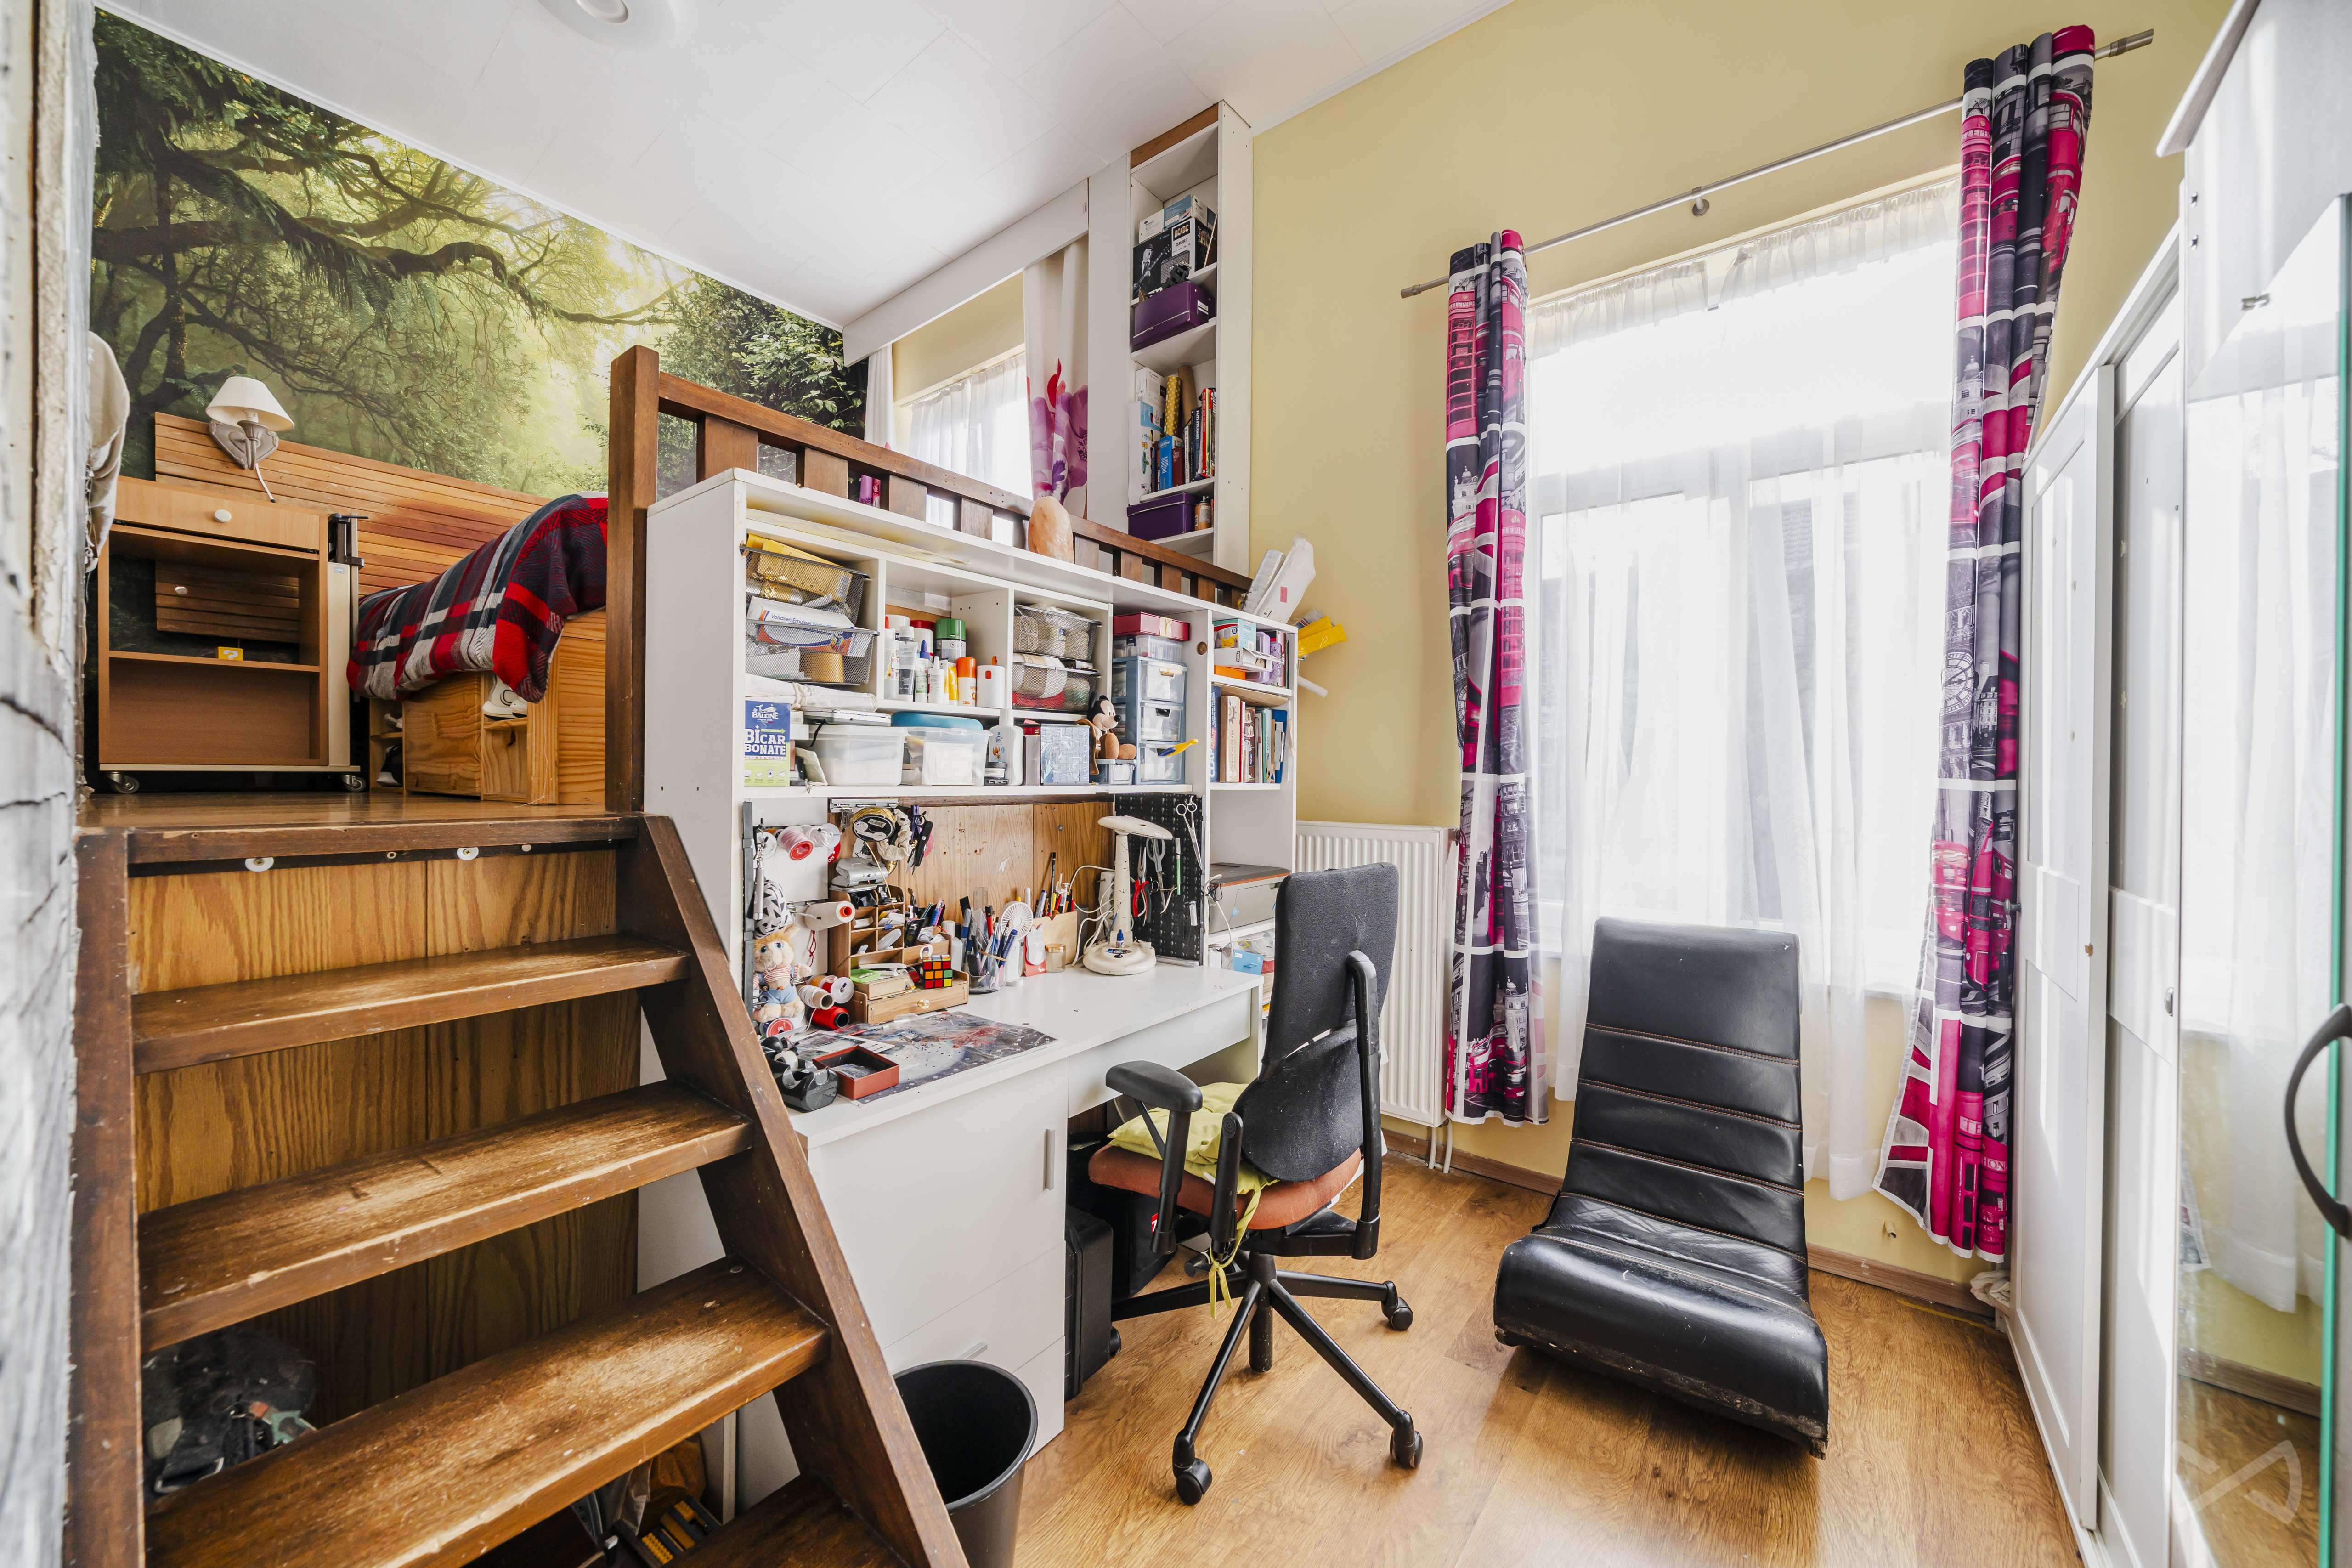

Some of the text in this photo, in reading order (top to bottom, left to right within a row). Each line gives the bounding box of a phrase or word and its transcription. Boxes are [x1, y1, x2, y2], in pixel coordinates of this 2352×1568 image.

[1174, 224, 1189, 238] AC/DC
[771, 614, 792, 623] Voltaren
[745, 744, 786, 755] BONATE
